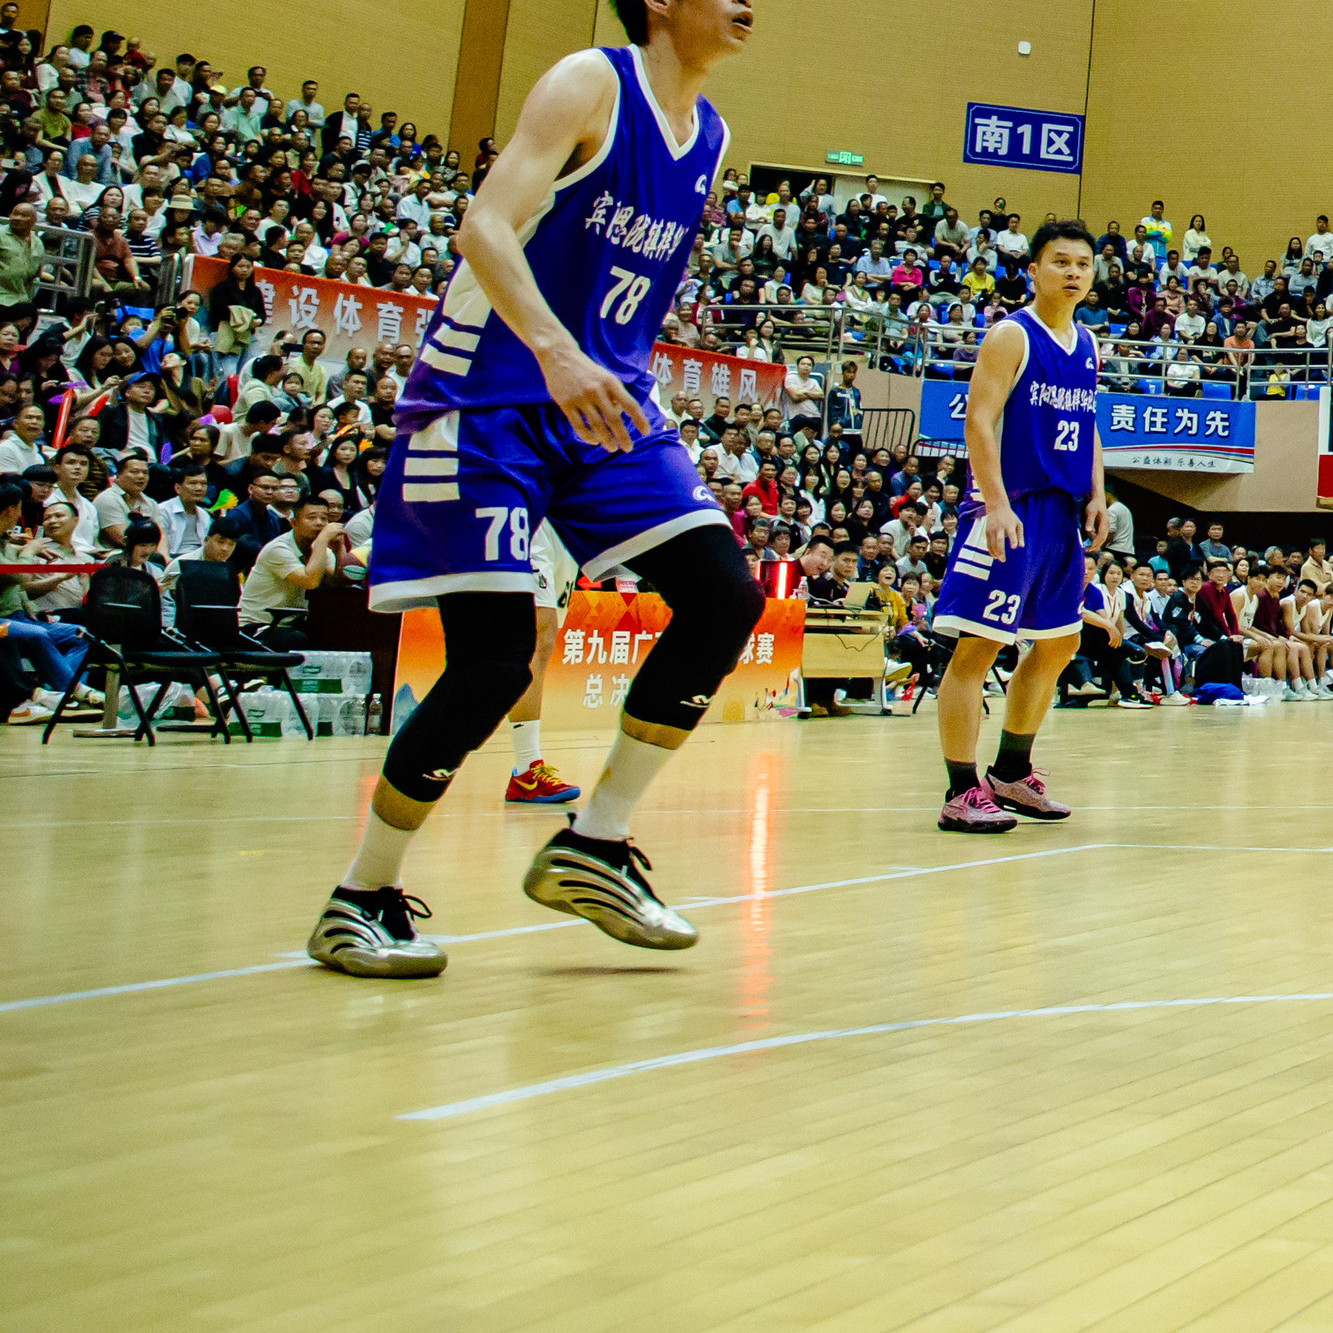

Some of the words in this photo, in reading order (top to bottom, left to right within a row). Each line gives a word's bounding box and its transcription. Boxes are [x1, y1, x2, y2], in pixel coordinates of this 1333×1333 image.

[974, 116, 1075, 162] 南1区
[600, 266, 651, 325] 78
[1054, 420, 1080, 451] 23
[1110, 404, 1230, 436] 责任为先
[476, 507, 529, 561] 78
[983, 589, 1021, 625] 23
[562, 629, 661, 665] 第九届广
